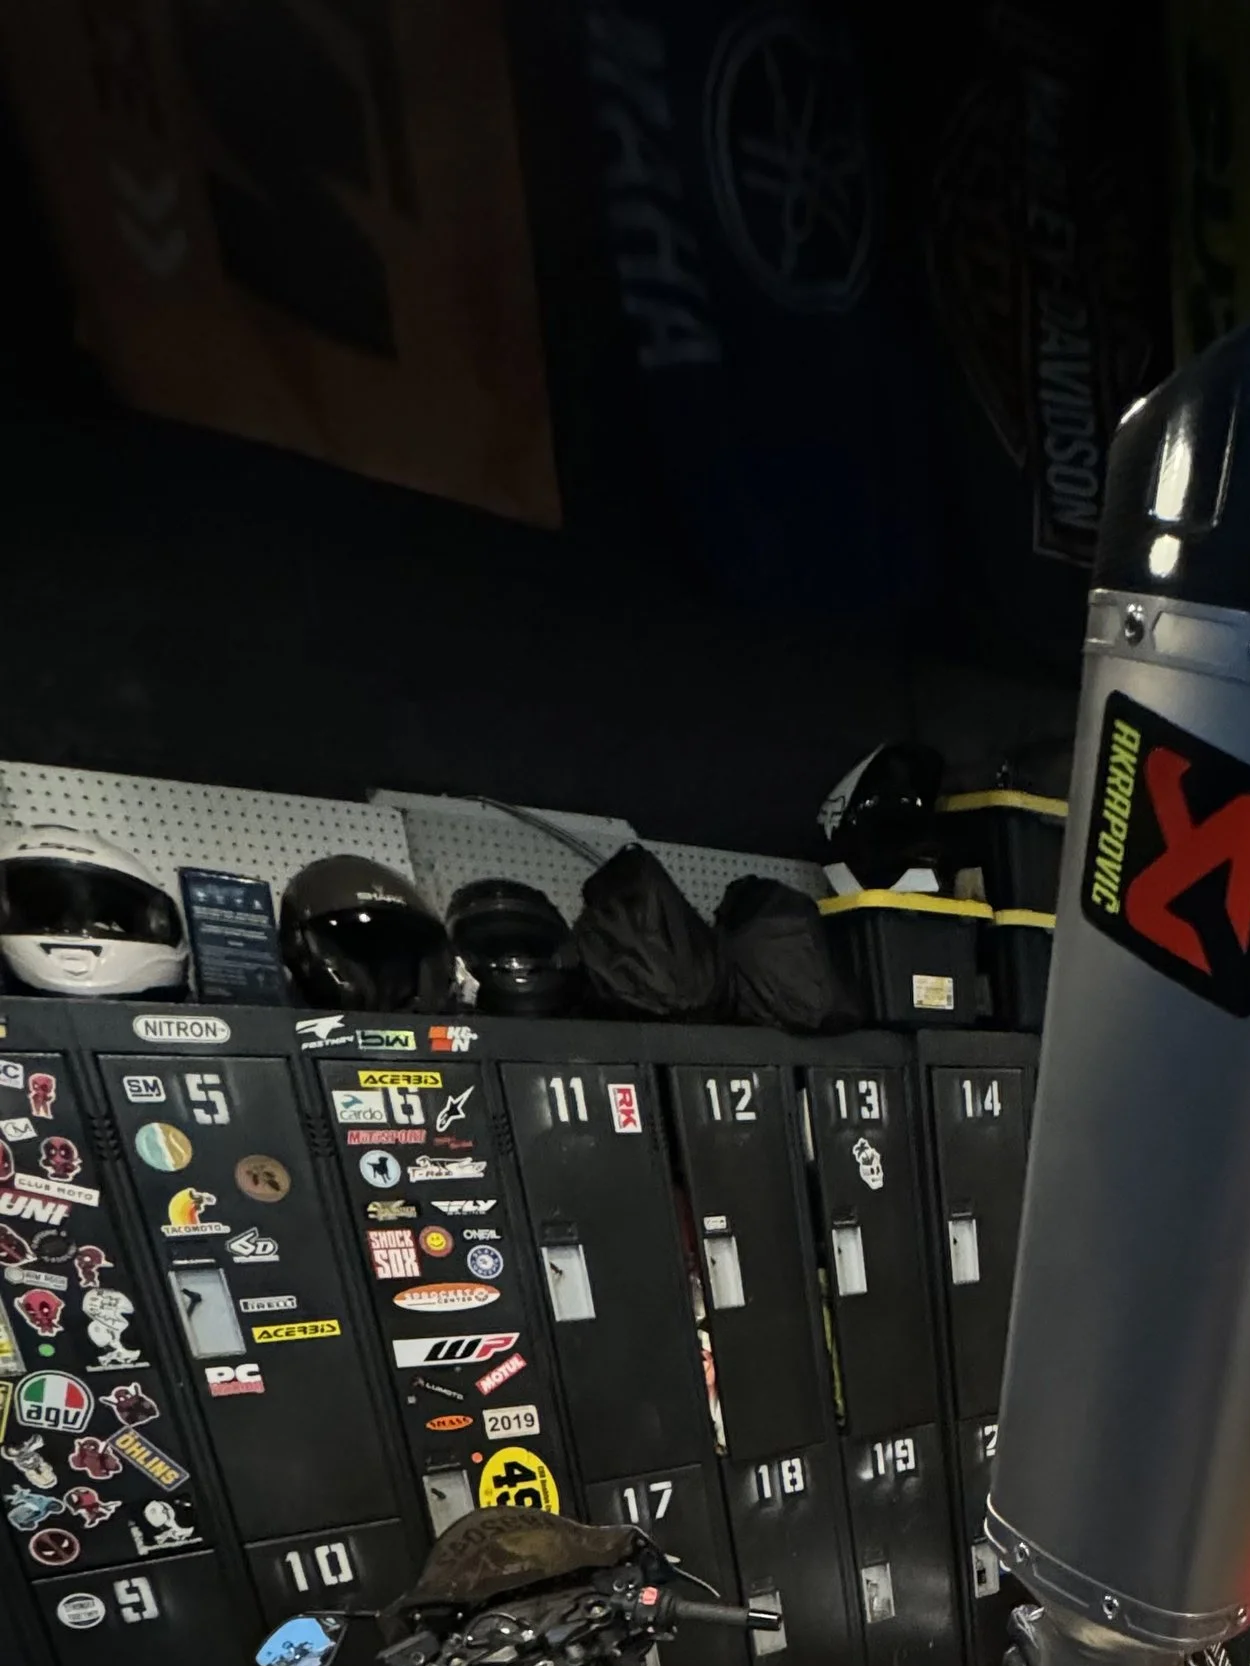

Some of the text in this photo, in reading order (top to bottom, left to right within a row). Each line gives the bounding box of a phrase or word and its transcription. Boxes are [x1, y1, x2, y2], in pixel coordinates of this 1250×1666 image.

[144, 1020, 218, 1038] NITRON
[184, 1073, 230, 1125] 5
[340, 1108, 384, 1121] cardo
[388, 1086, 425, 1125] 6
[549, 1077, 588, 1122] 11
[616, 1087, 639, 1129] RK
[706, 1078, 756, 1122] 12
[835, 1080, 880, 1120] 13
[962, 1079, 1001, 1118] 14
[368, 1230, 415, 1249] SHOCK
[373, 1248, 421, 1279] SOX
[424, 1336, 514, 1362] WP
[482, 1354, 524, 1392] MOTUL
[26, 1404, 81, 1428] agv
[488, 1412, 535, 1432] 2019
[872, 1438, 915, 1475] 19
[755, 1458, 804, 1499] 18
[623, 1481, 673, 1524] 17
[284, 1541, 353, 1592] 10
[113, 1577, 159, 1624] 9
